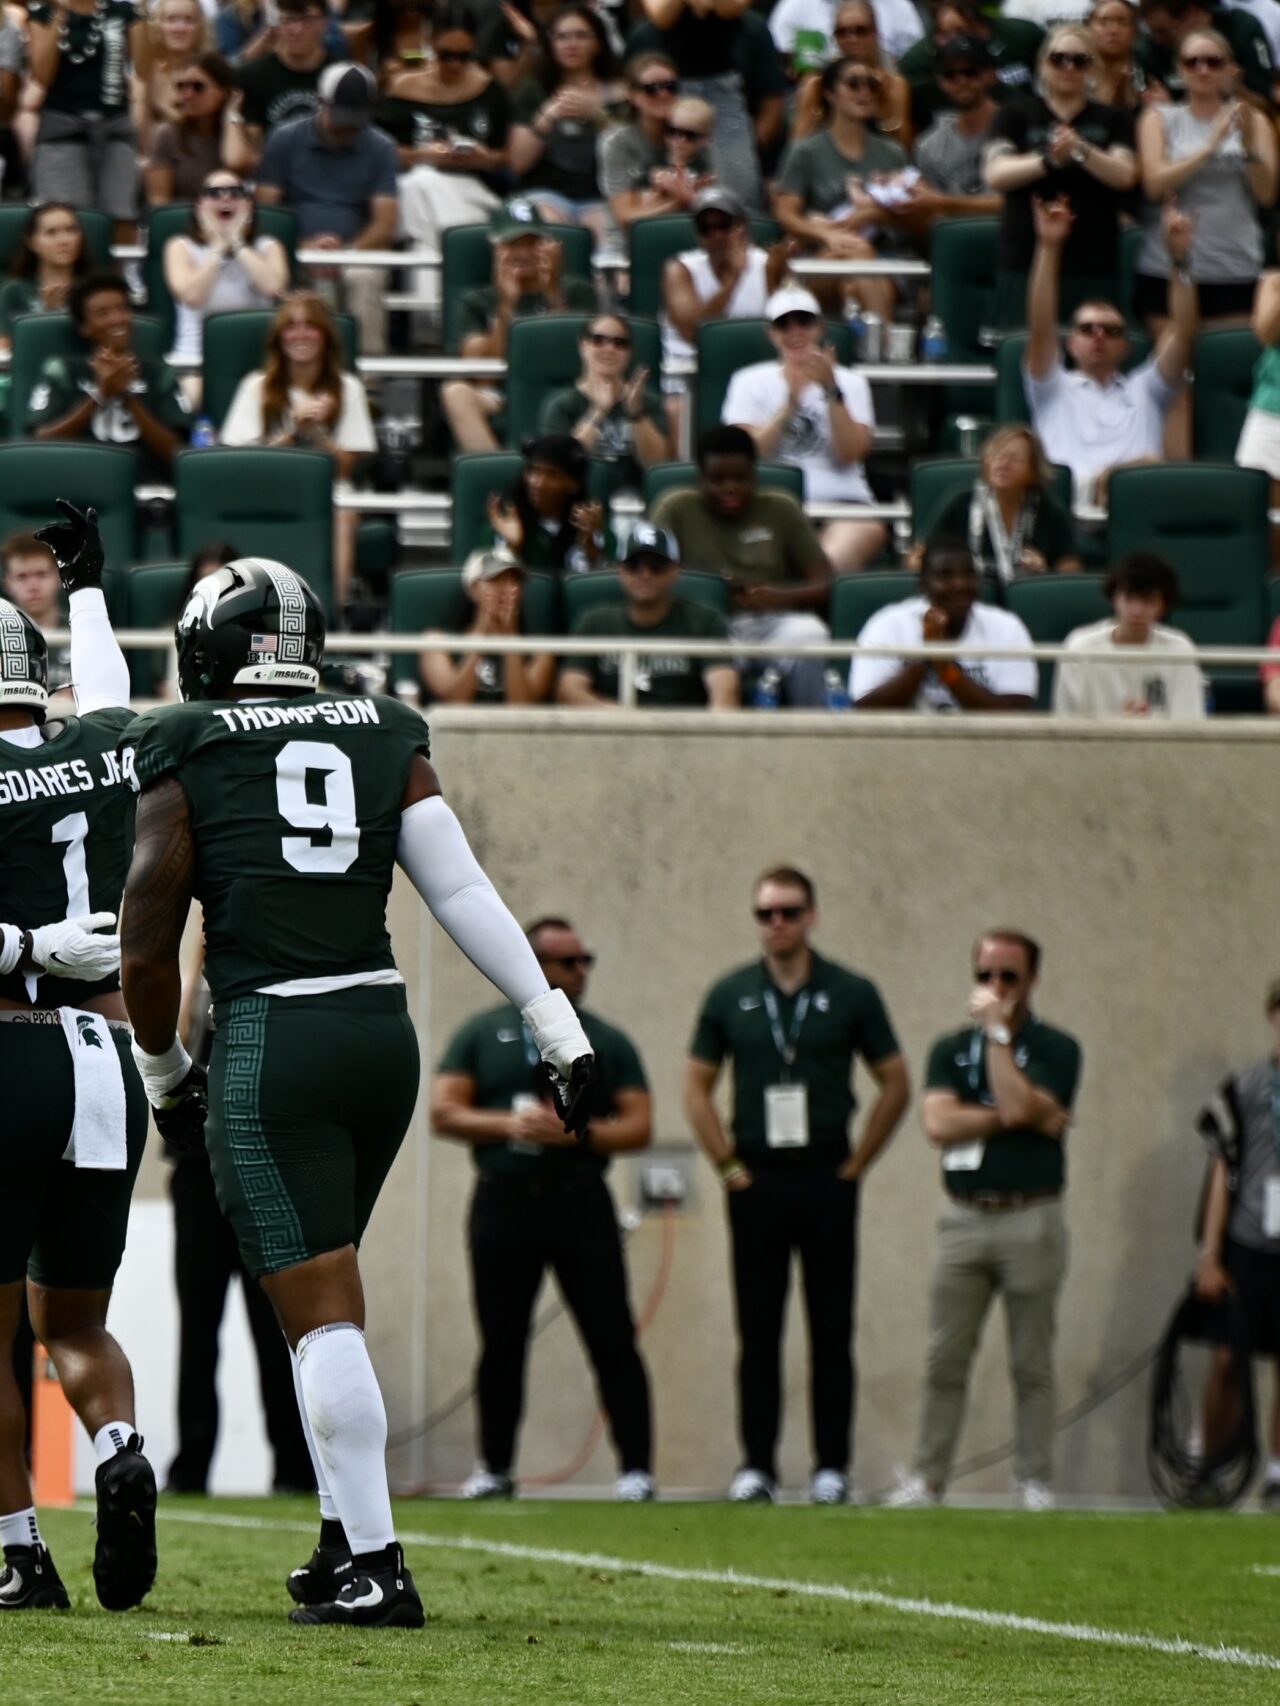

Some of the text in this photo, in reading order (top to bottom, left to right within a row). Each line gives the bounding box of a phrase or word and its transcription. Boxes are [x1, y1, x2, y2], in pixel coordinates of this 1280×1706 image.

[4, 685, 38, 696] msufcu
[275, 669, 309, 680] msufcu
[213, 698, 380, 732] THOMPSON
[275, 740, 361, 874] 9
[51, 811, 91, 920] 1
